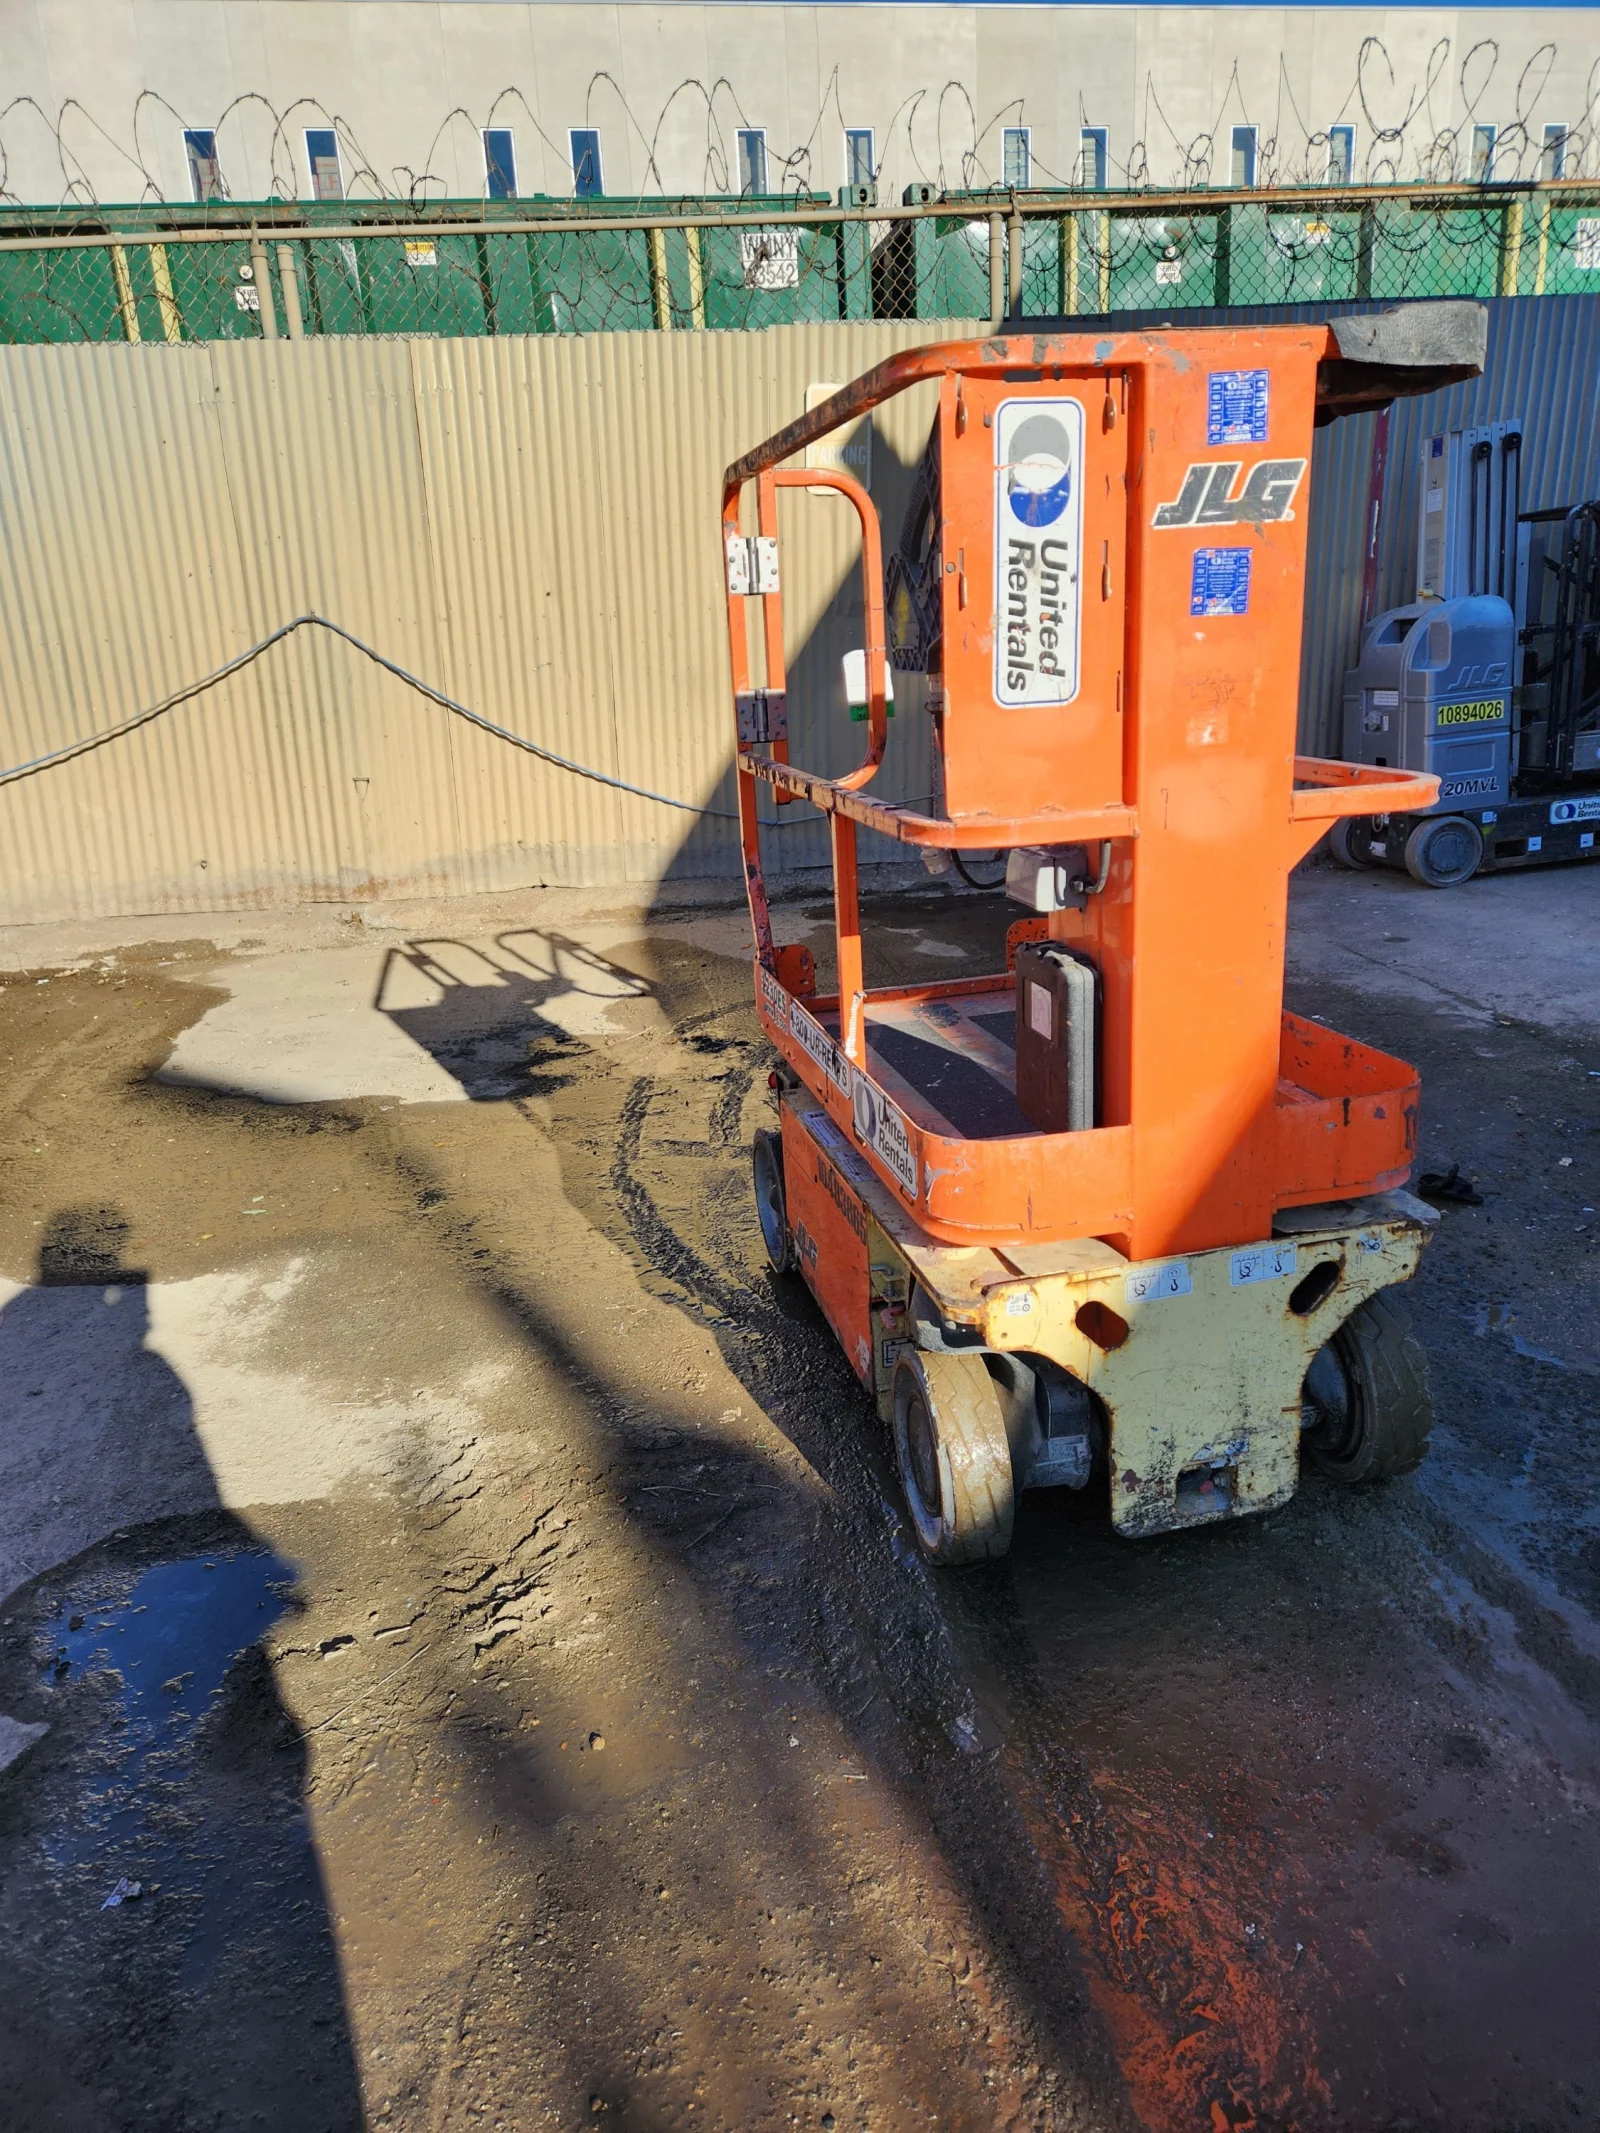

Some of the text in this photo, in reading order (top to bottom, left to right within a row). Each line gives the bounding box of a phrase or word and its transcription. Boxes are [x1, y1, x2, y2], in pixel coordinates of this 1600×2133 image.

[1151, 458, 1307, 530] JLG
[1007, 537, 1036, 692] Rentals
[1039, 538, 1069, 678] United
[1447, 662, 1507, 691] JLG
[1438, 701, 1502, 724] 10894026
[1444, 777, 1499, 797] 20MVL
[878, 1101, 909, 1154] United
[878, 1127, 913, 1184] Rentals
